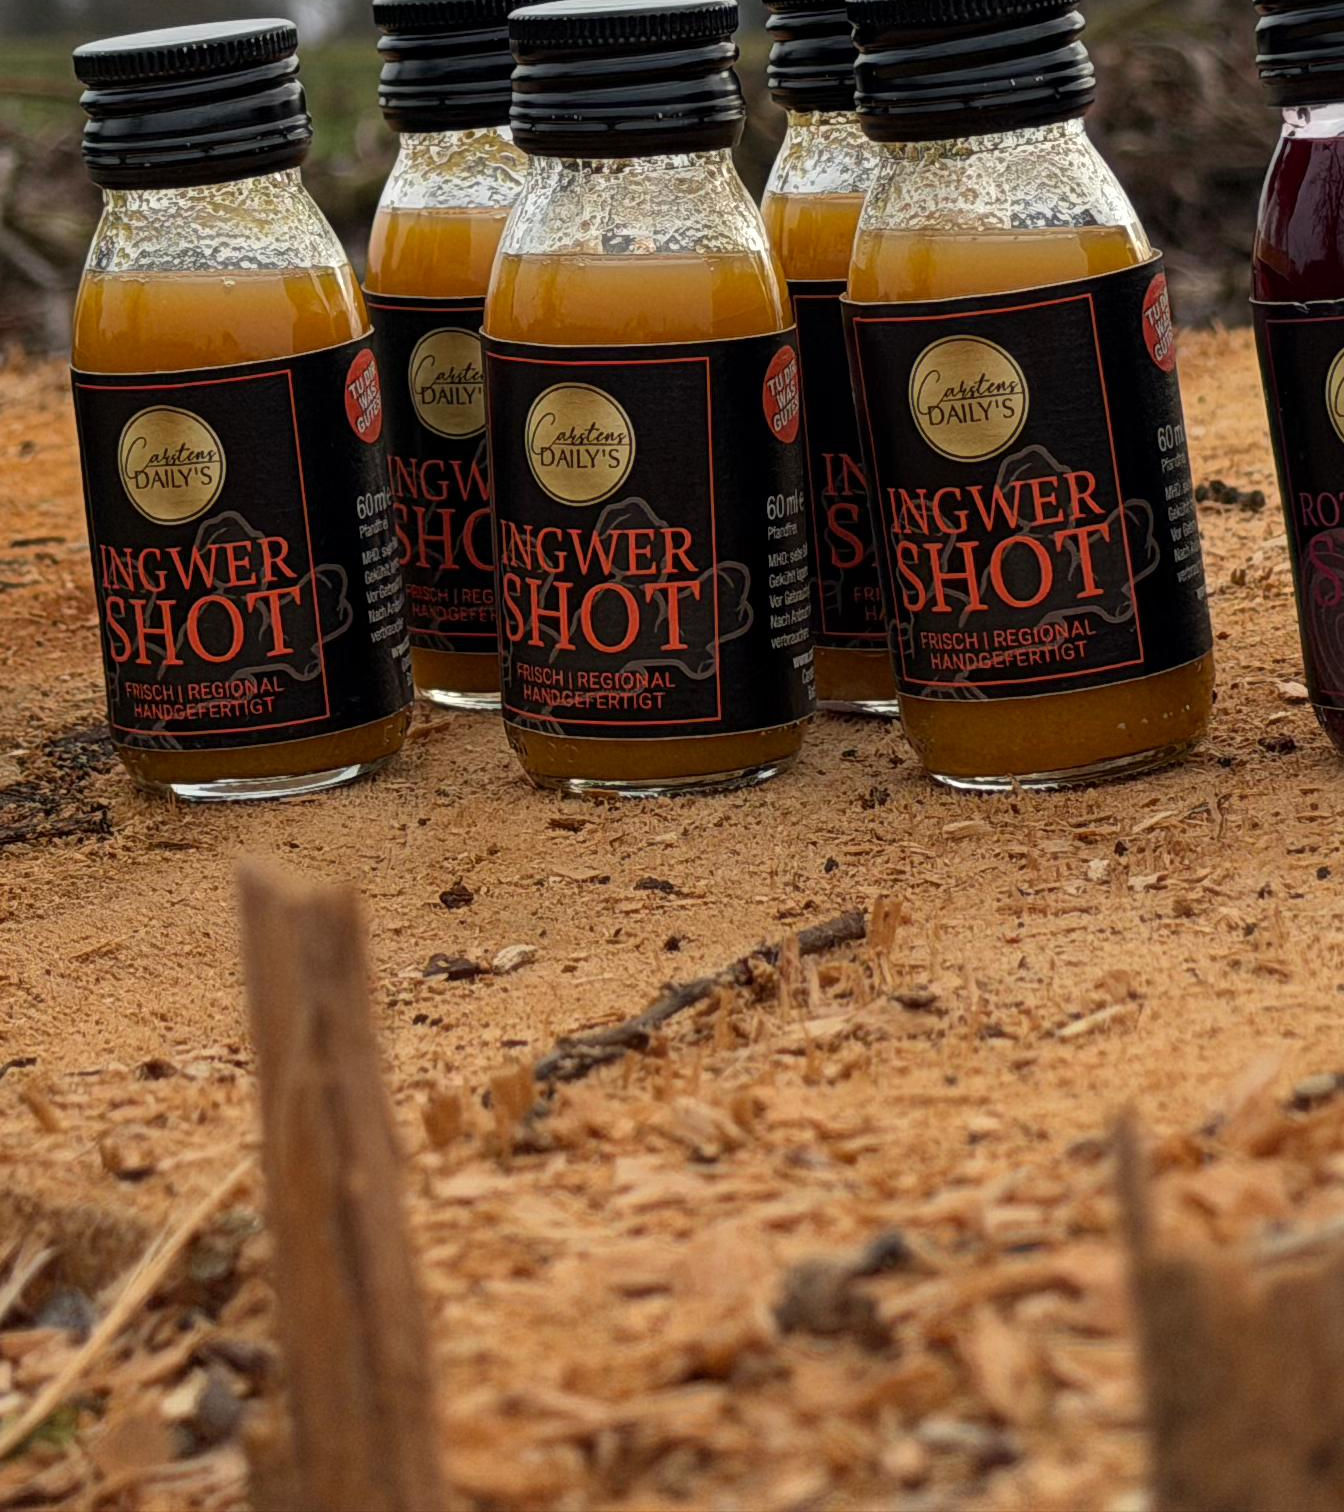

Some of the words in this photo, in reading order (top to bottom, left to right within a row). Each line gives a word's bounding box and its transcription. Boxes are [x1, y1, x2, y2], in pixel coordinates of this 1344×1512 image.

[414, 354, 483, 395] Carste
[421, 386, 482, 405] DAILY'
[917, 369, 1020, 415] Carstens
[928, 397, 1016, 426] DAILY'S
[530, 412, 627, 455] Carstens
[1158, 424, 1174, 452] 60
[125, 436, 218, 480] Carstens
[540, 446, 620, 469] DAILY'S
[134, 465, 213, 490] DAILY'S
[387, 455, 491, 502] INGW
[357, 493, 374, 519] 60
[767, 494, 785, 520] 60
[887, 469, 1106, 536] INGWER
[393, 503, 497, 571] SHO
[500, 518, 699, 577] INGWER
[99, 535, 298, 592] INGWER
[896, 523, 1112, 614] SHOT
[104, 586, 301, 666] SHOT
[502, 571, 703, 654] SHOT
[920, 629, 978, 651] FRISCH
[993, 617, 1096, 646] REGIONAL
[930, 640, 1088, 671] HANDGEFERTIGT
[125, 680, 175, 701] FRISCH
[188, 676, 284, 700] REGIONAL
[516, 662, 564, 686] FRISCH
[578, 669, 676, 690] REGIONAL
[133, 697, 275, 721] HANDGEFERTIGT
[523, 686, 666, 711] HANDGEFERTIGT
